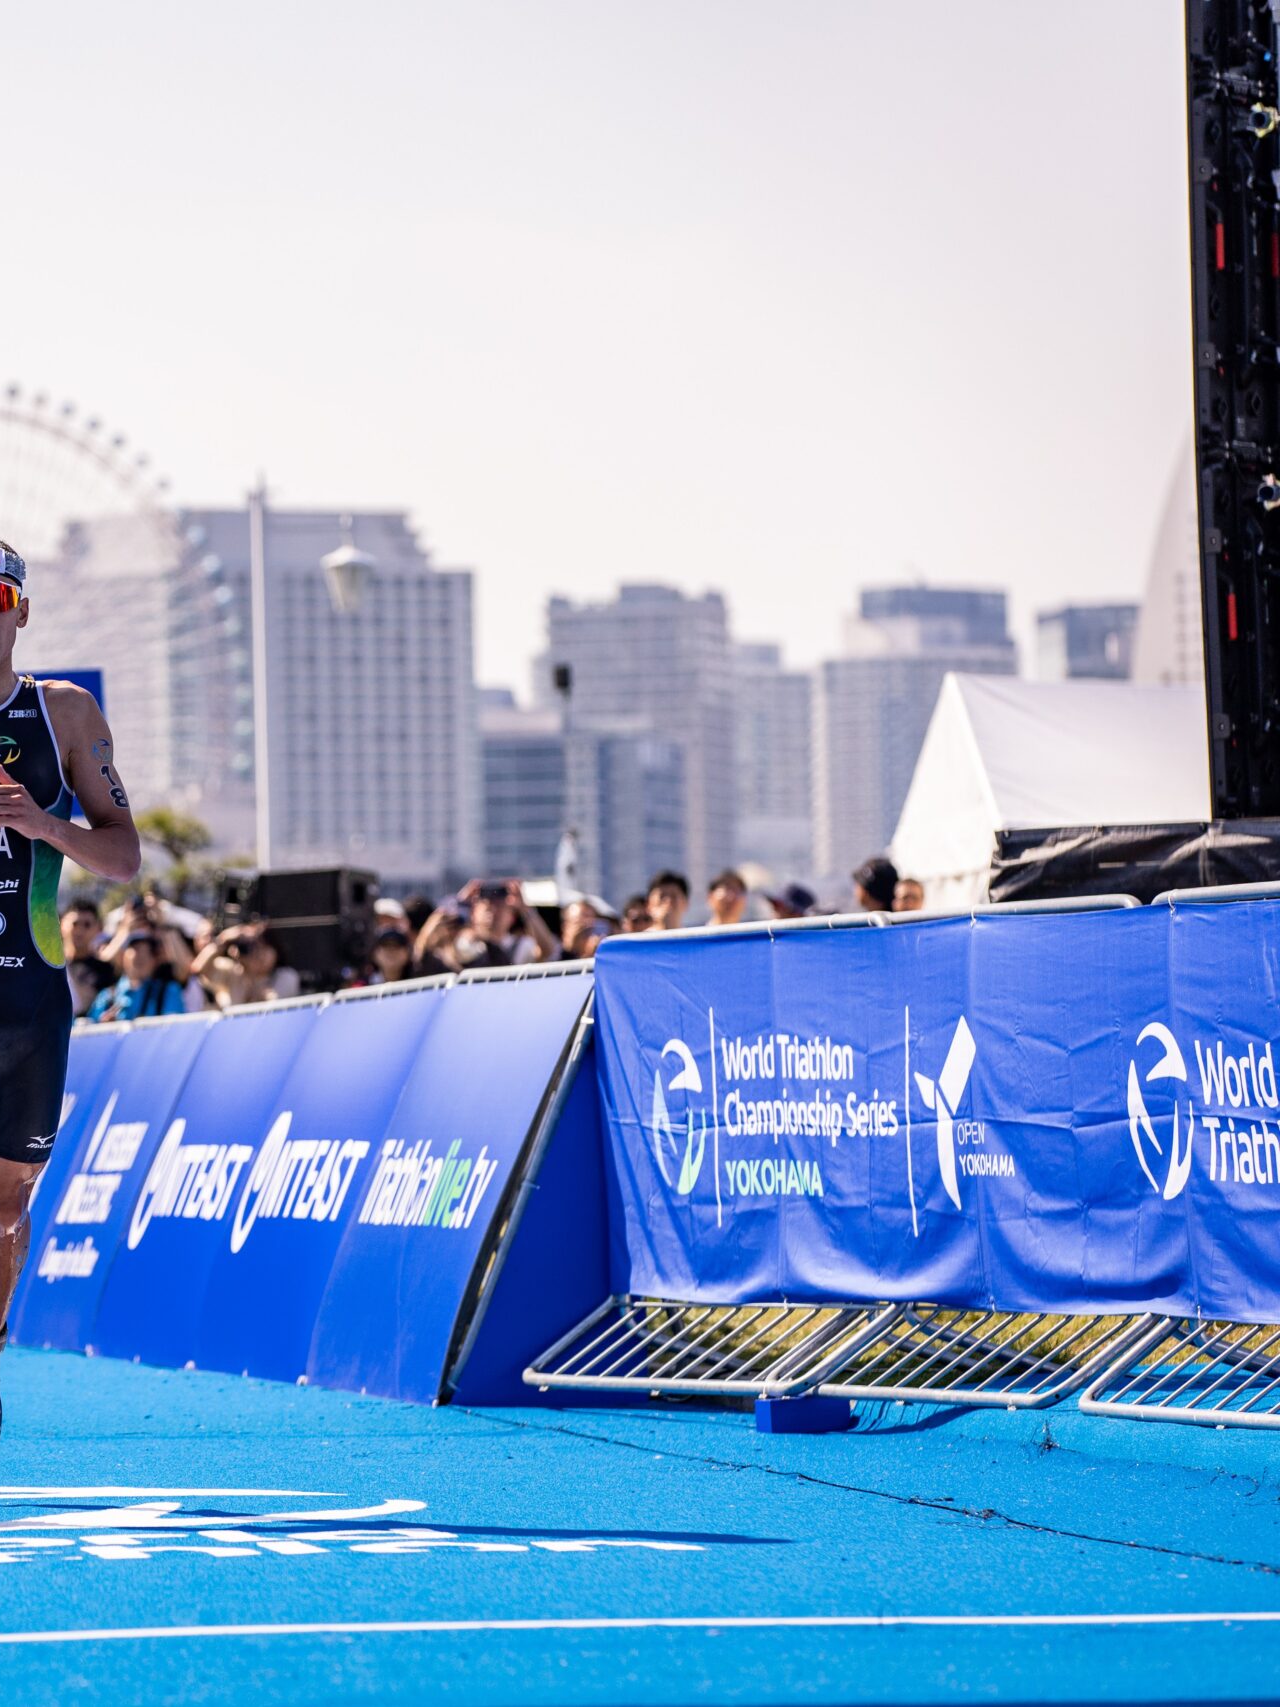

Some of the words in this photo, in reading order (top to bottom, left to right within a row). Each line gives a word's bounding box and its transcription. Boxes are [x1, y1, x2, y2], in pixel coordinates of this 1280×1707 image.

[721, 1035, 775, 1081] World
[776, 1034, 854, 1081] Triathlon
[1194, 1040, 1279, 1108] World
[724, 1088, 843, 1147] Championship
[846, 1088, 899, 1137] Series
[957, 1121, 985, 1146] OPEN
[959, 1153, 1015, 1177] YOKOHAMA
[1201, 1116, 1280, 1185] Triath
[725, 1159, 824, 1197] YOKOHAMA
